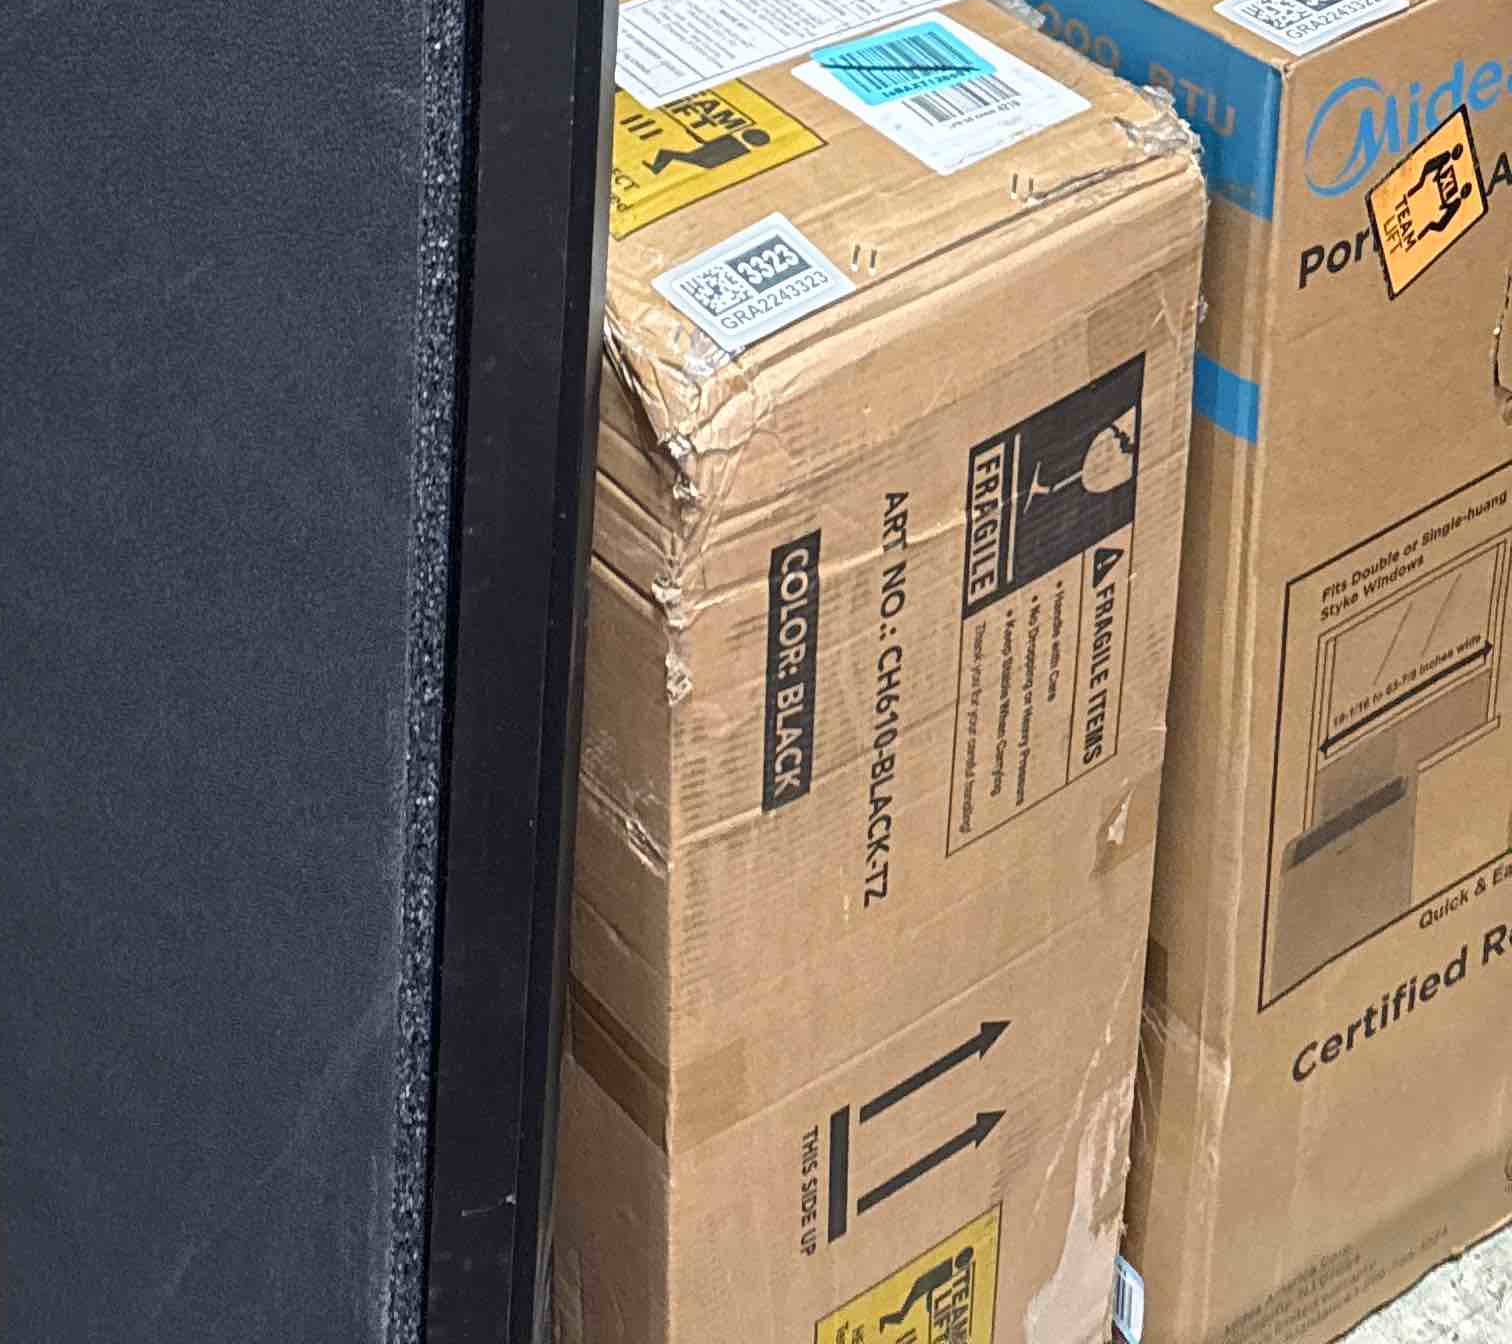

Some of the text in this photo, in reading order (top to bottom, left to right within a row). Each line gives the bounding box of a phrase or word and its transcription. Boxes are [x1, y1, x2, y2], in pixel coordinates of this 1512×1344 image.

[1304, 59, 1512, 198] Mide
[737, 242, 801, 286] 3323
[1382, 214, 1405, 256] LIFT
[1394, 193, 1417, 253] TEAM
[720, 270, 829, 330] GRA2243323
[883, 490, 910, 554] ART
[971, 457, 1001, 596] FRAGILE
[1320, 581, 1350, 605] Fits
[1351, 548, 1401, 587] Double
[1402, 538, 1419, 558] or
[772, 547, 810, 797] COLOR: BLACK
[1081, 583, 1116, 765] FRAGILE ITEMS
[863, 643, 904, 909] CH610-BLACK-TZ
[1418, 887, 1470, 930] Quick
[1474, 877, 1487, 897] &
[1291, 943, 1469, 1083] Certified
[799, 1124, 819, 1258] THIS SIDE UP
